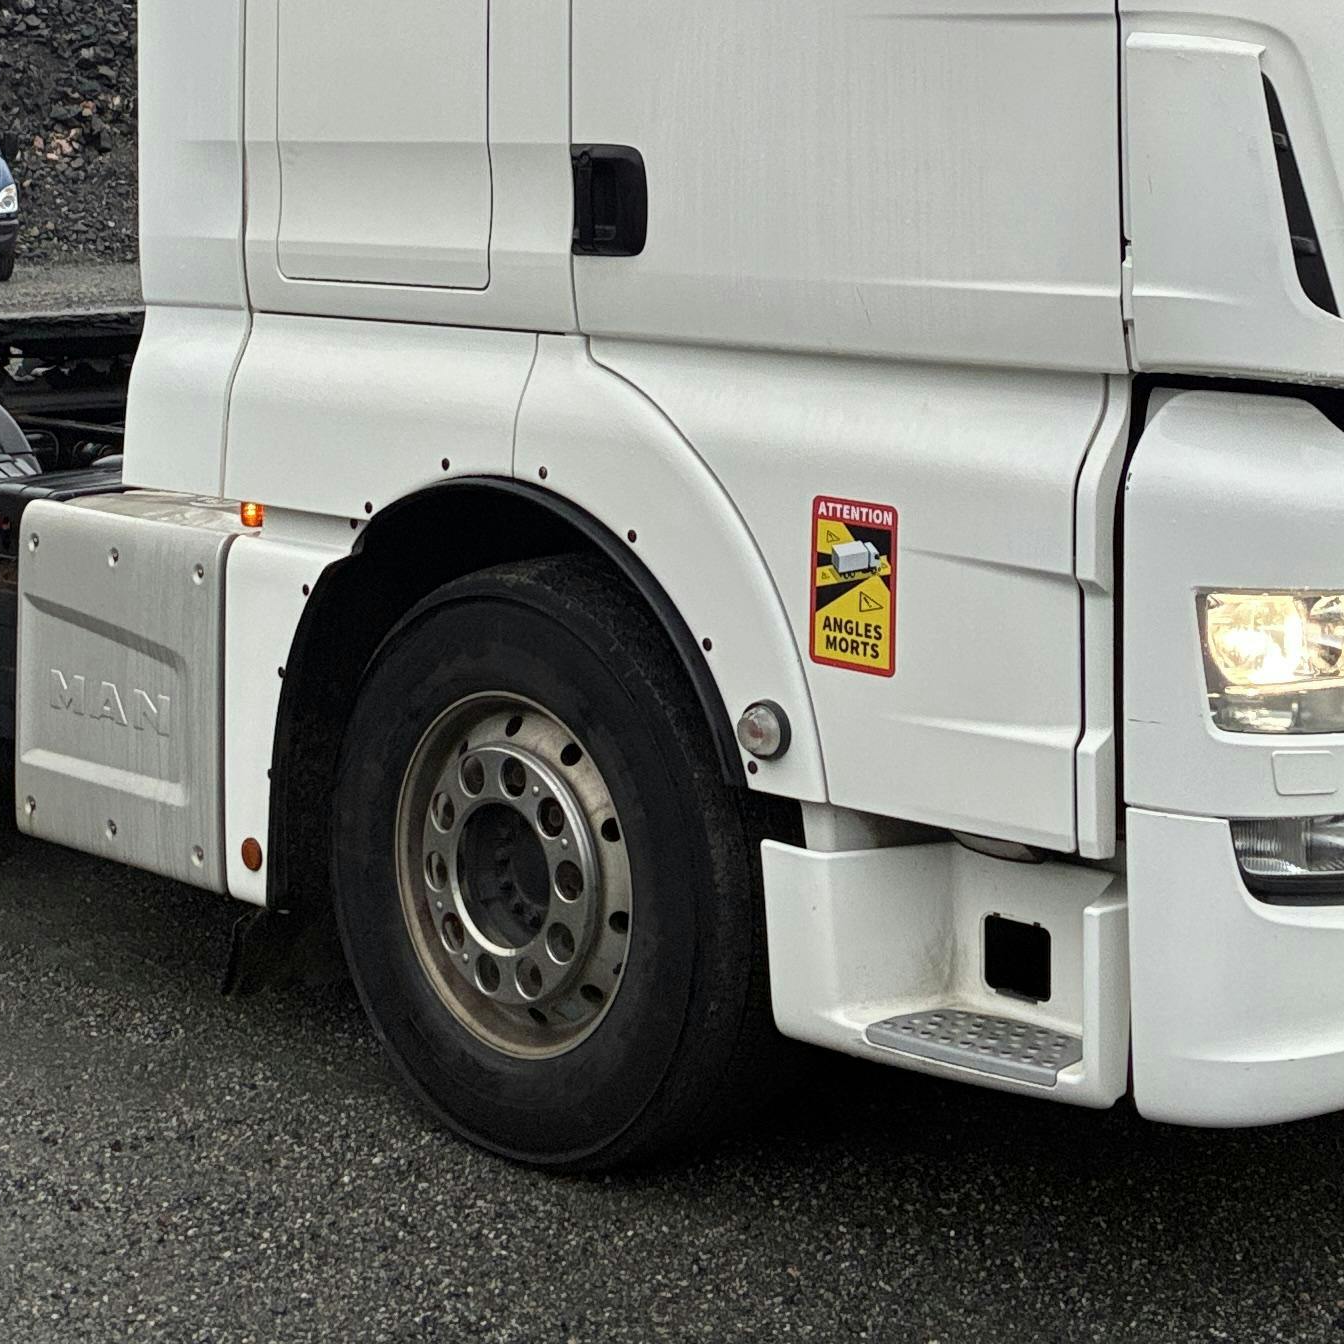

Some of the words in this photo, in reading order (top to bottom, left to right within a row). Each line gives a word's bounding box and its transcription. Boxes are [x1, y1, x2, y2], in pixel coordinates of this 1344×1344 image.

[817, 500, 894, 526] ATTENTION
[822, 615, 883, 641] ANGLES
[825, 634, 880, 659] MORTS
[50, 669, 171, 738] MAN
